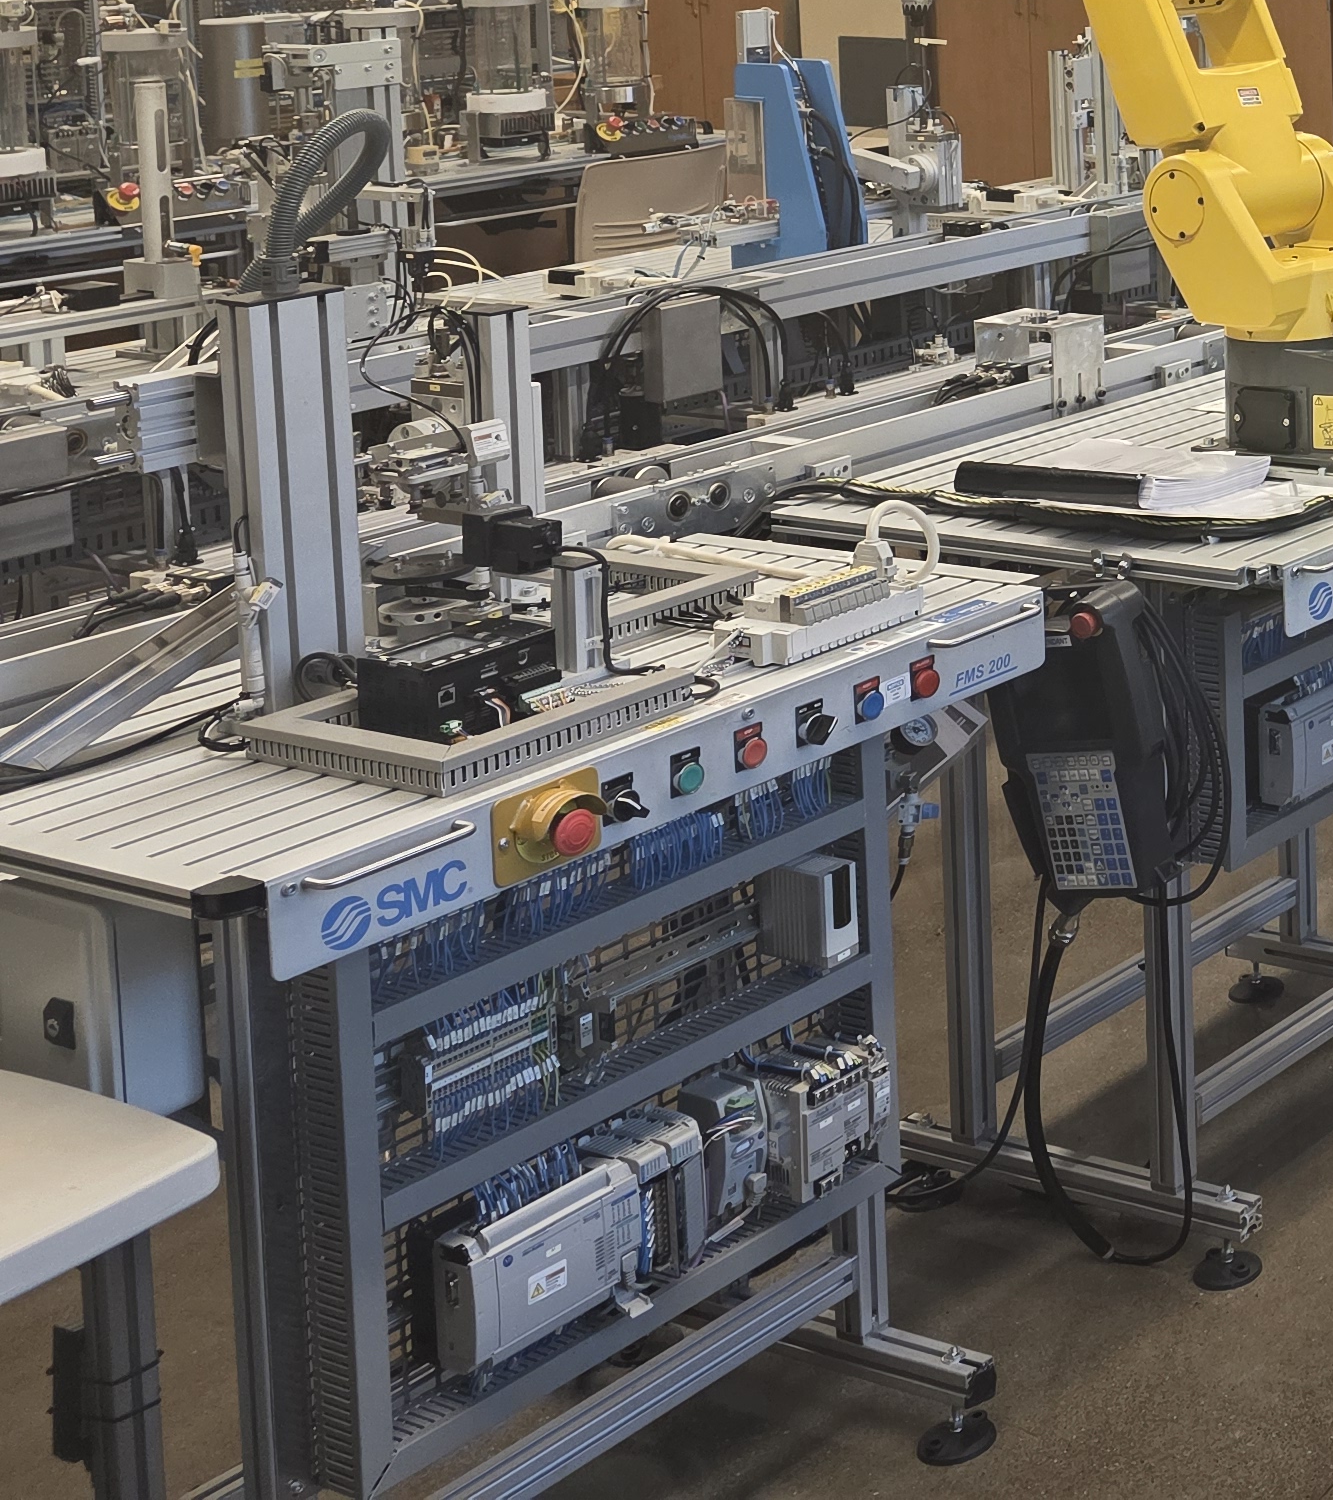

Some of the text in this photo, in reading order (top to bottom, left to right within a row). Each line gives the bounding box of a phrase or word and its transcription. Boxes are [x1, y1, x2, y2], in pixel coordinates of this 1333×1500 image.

[955, 664, 984, 688] FMS
[988, 653, 1011, 675] 200
[376, 859, 468, 927] SMC
